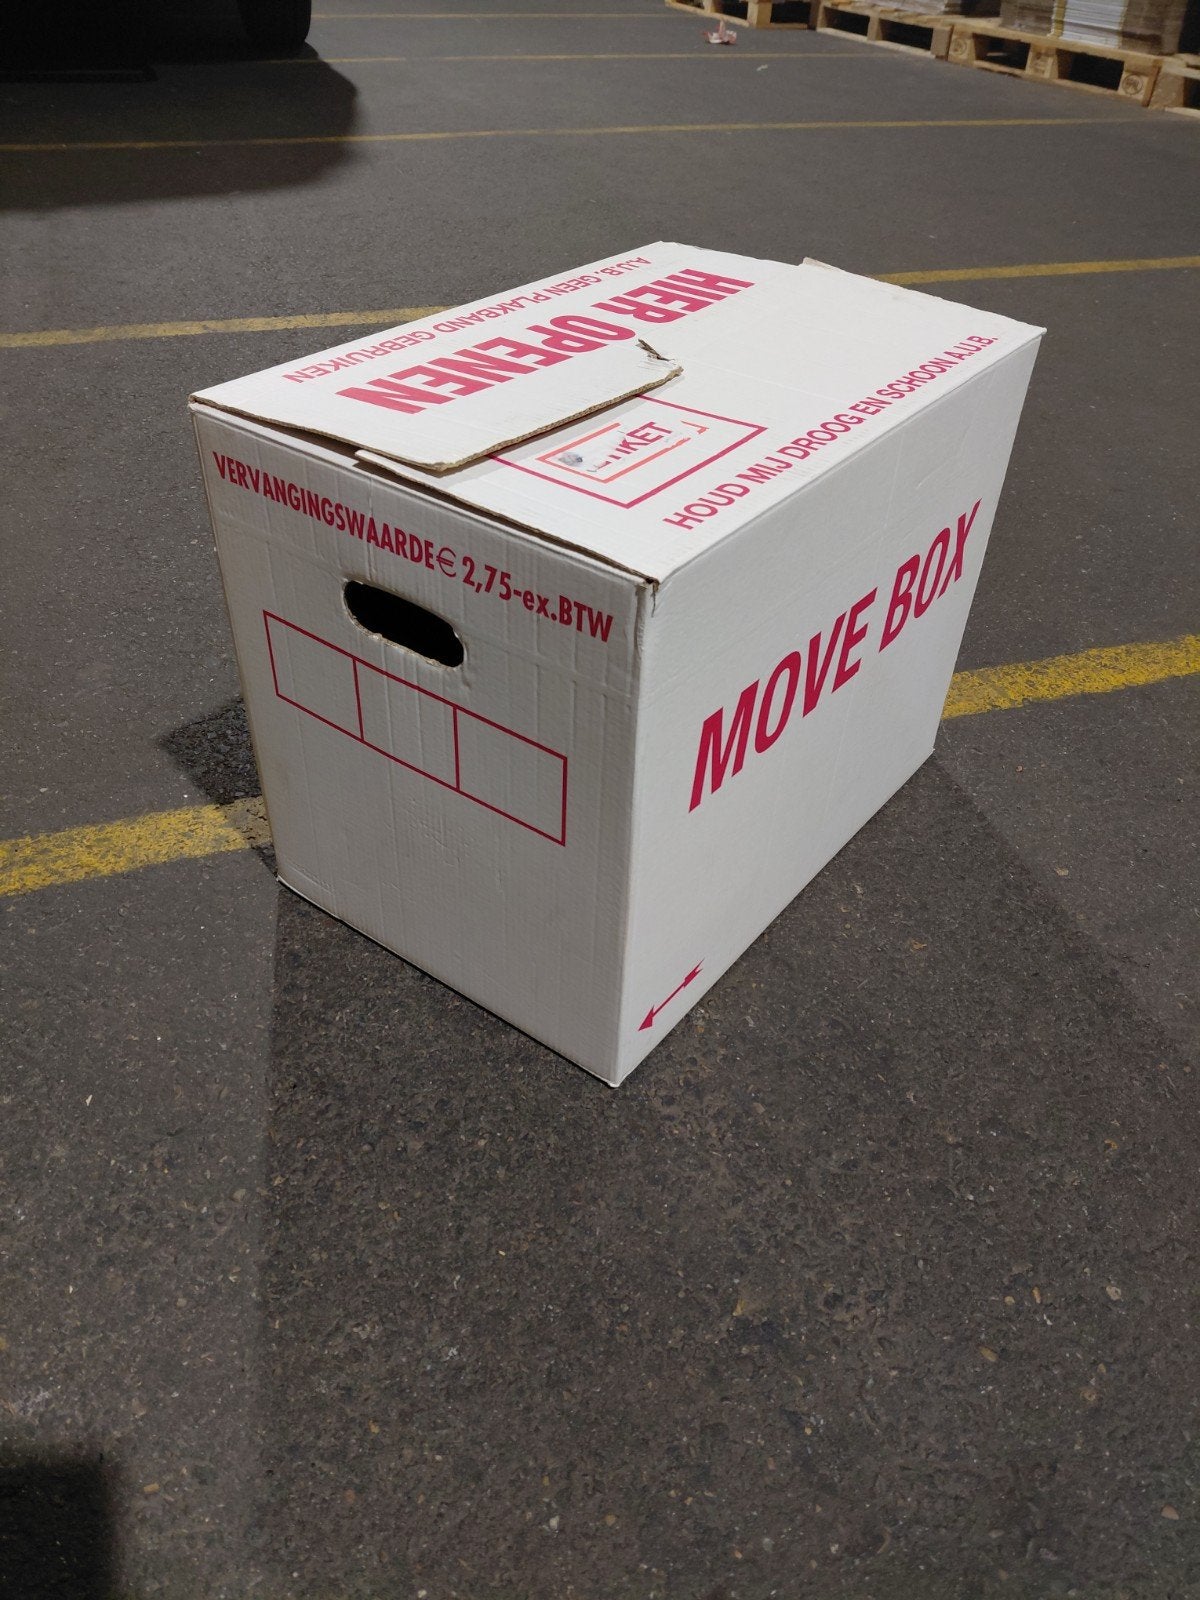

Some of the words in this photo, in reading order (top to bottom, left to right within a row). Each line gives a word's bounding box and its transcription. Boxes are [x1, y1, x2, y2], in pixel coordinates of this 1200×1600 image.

[433, 291, 552, 333] PLAKBAND
[544, 275, 602, 296] GEEN
[592, 268, 755, 325] HIER
[282, 331, 436, 384] GEBRUIKEN
[335, 315, 637, 415] OPENEN
[662, 482, 751, 531] HOUD
[735, 456, 793, 484] MIJ
[776, 413, 866, 460] DROOG
[848, 396, 893, 416] EN
[876, 357, 959, 399] SCHOON
[944, 335, 999, 361] A.U.B.
[688, 587, 878, 813] MOVE
[879, 499, 982, 653] BOX
